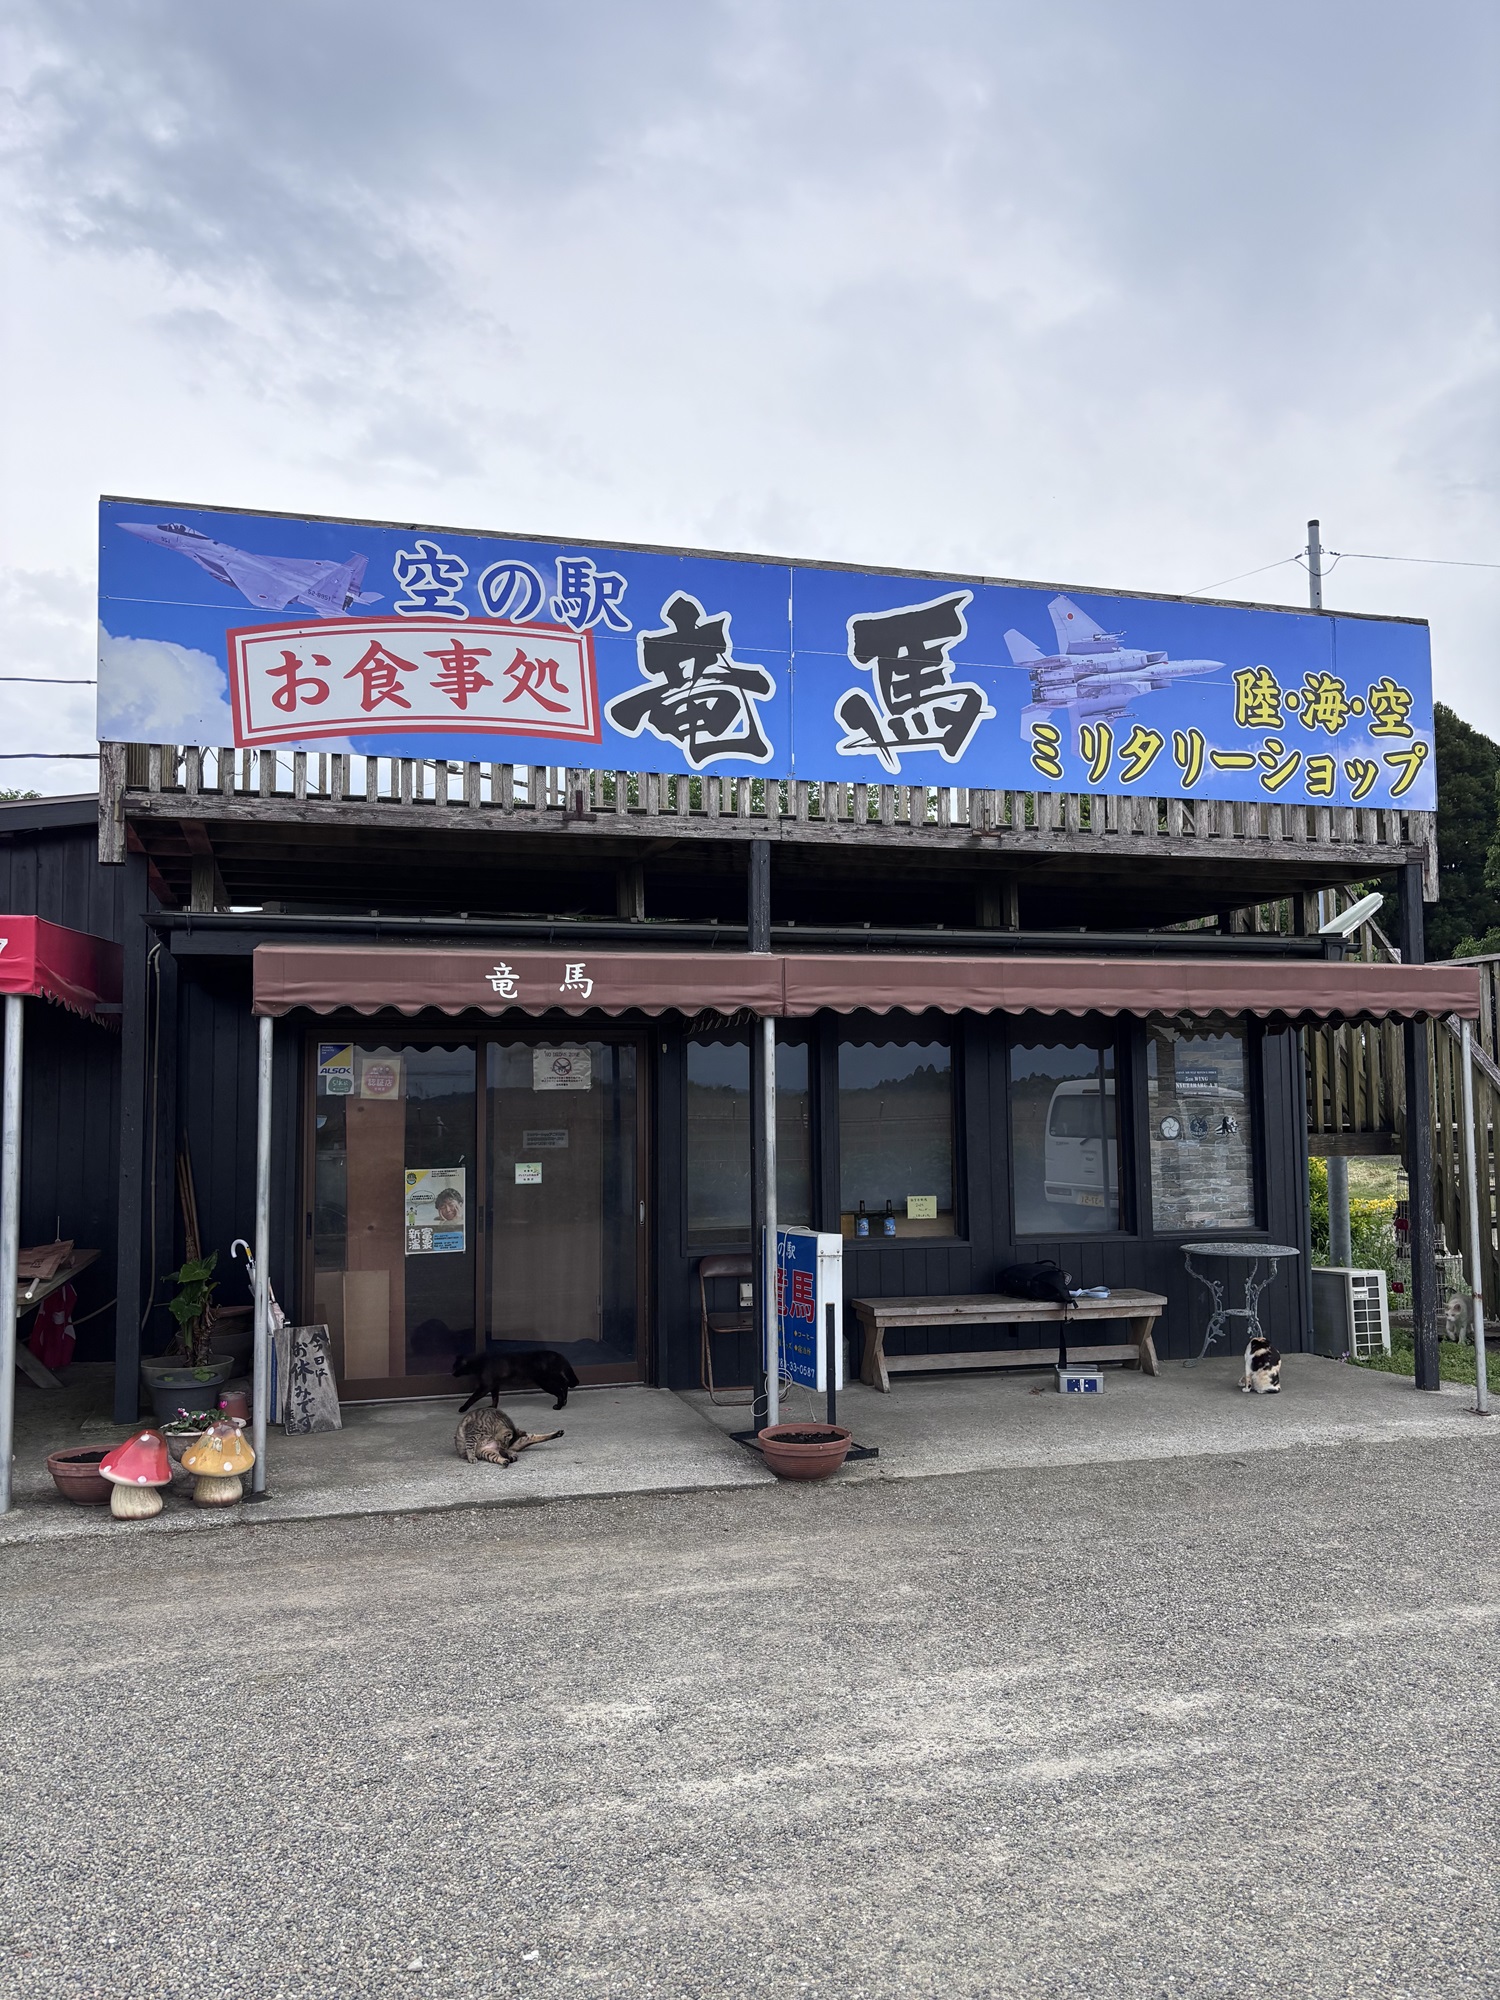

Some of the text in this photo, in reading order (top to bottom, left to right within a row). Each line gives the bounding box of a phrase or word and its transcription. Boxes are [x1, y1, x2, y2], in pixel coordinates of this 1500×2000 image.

[393, 540, 632, 632] 空の駅
[265, 638, 571, 714] お食事処
[1030, 721, 1429, 803] ミリタリーショップ
[320, 1067, 351, 1075] ALSOK
[367, 1078, 393, 1087] 認証店
[777, 1241, 796, 1260] の駅
[308, 1332, 329, 1387] 今日は
[778, 1358, 815, 1378] 8-33-0587
[290, 1342, 315, 1434] お休みです
